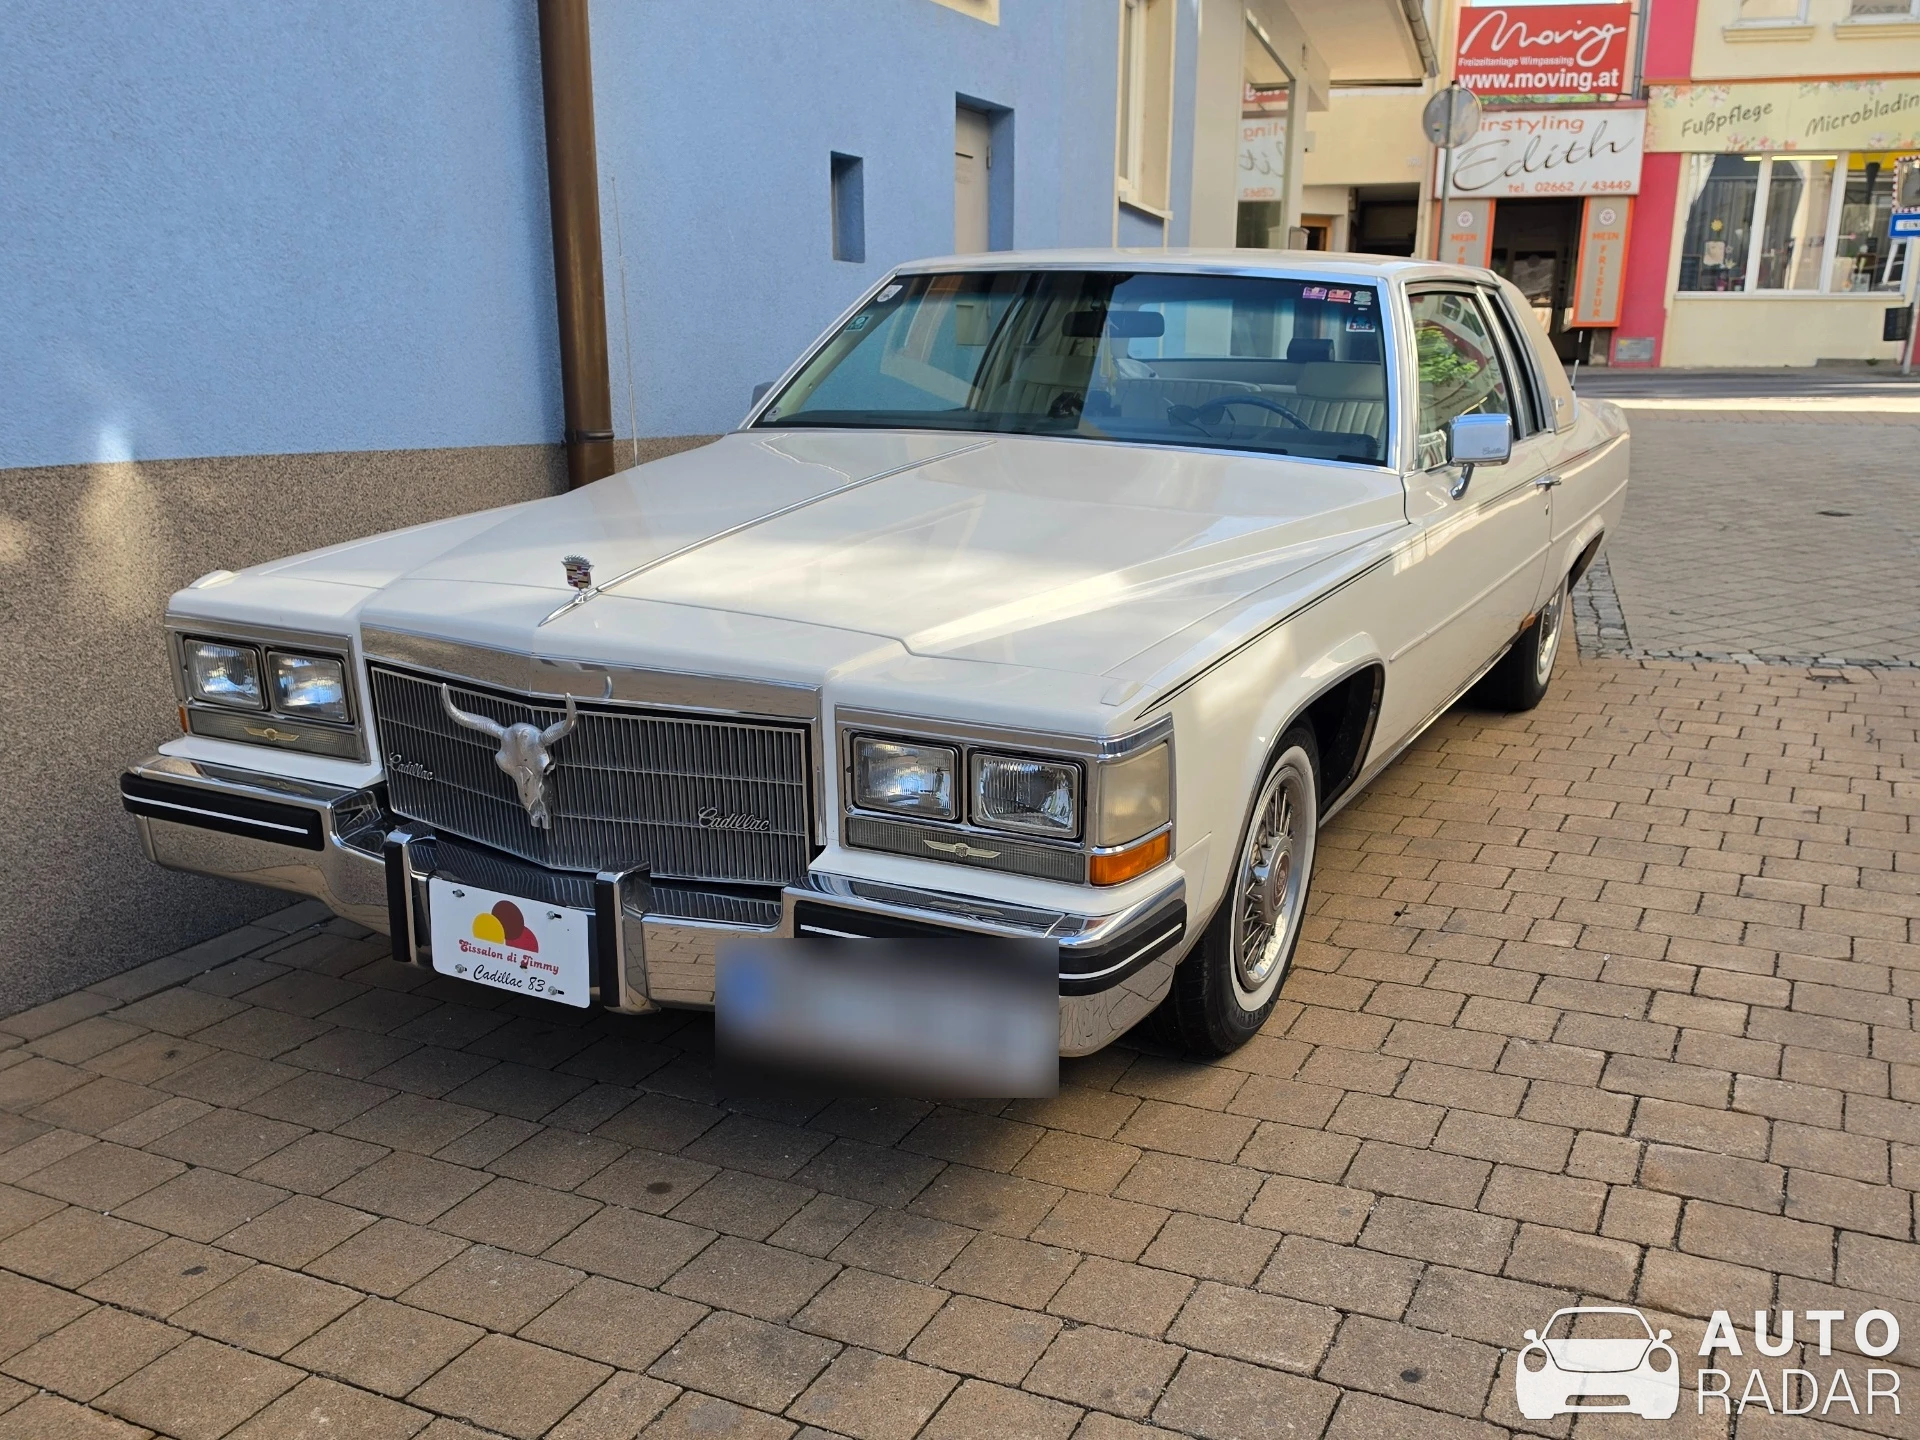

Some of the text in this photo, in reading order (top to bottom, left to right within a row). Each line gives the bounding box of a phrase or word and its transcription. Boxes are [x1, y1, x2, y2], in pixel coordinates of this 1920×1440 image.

[1459, 10, 1626, 67] Moving
[1458, 56, 1574, 67] Freizeitanlage Wimpassing
[1459, 68, 1619, 92] www.moving.at
[1478, 115, 1584, 134] irstyling
[1681, 101, 1773, 137] Fußpflege
[1453, 120, 1634, 191] Edith
[1508, 183, 1528, 193] tel.
[1535, 181, 1574, 192] 02662
[1592, 180, 1632, 191] 43449
[1592, 231, 1619, 241] MEIN
[1592, 245, 1608, 318] FRISEUR
[387, 752, 433, 780] Cadillac
[698, 806, 769, 830] Cadillac
[458, 939, 559, 975] Eissalon di Timmy
[473, 964, 545, 992] Cadillac 83
